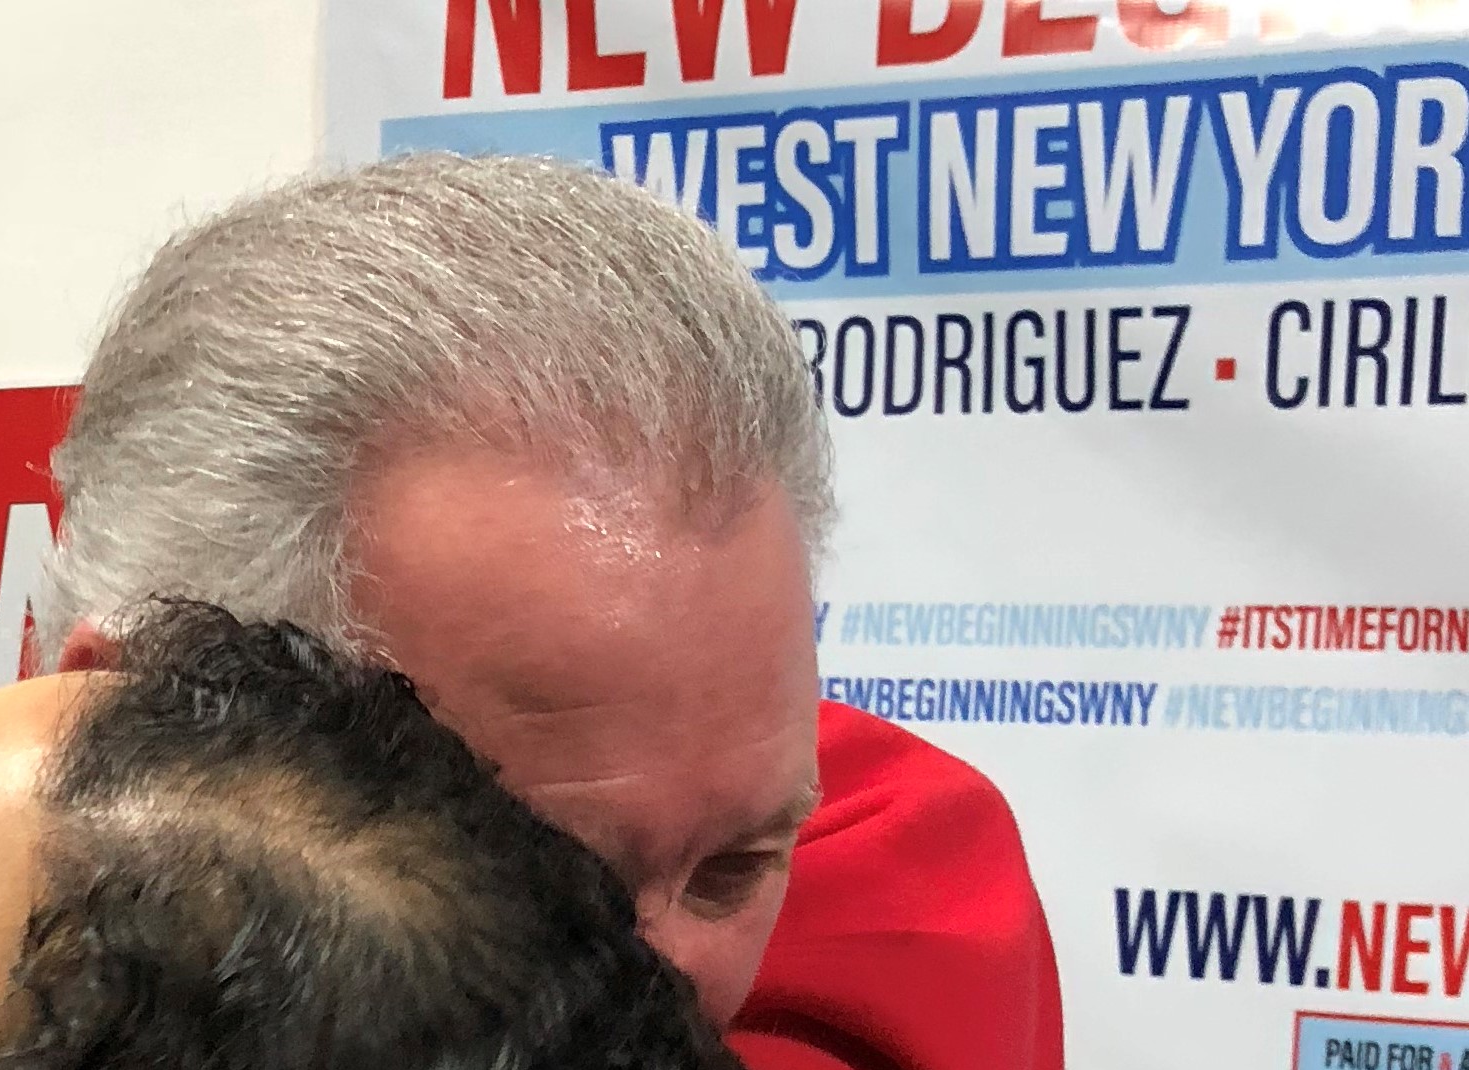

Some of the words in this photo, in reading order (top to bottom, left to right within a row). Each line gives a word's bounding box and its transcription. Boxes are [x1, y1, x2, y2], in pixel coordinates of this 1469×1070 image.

[929, 95, 1192, 260] NEW
[1219, 76, 1469, 248] YOR
[1266, 295, 1468, 410] CIRIL
[840, 601, 1213, 649] #NEWBEGINNINGSWNY
